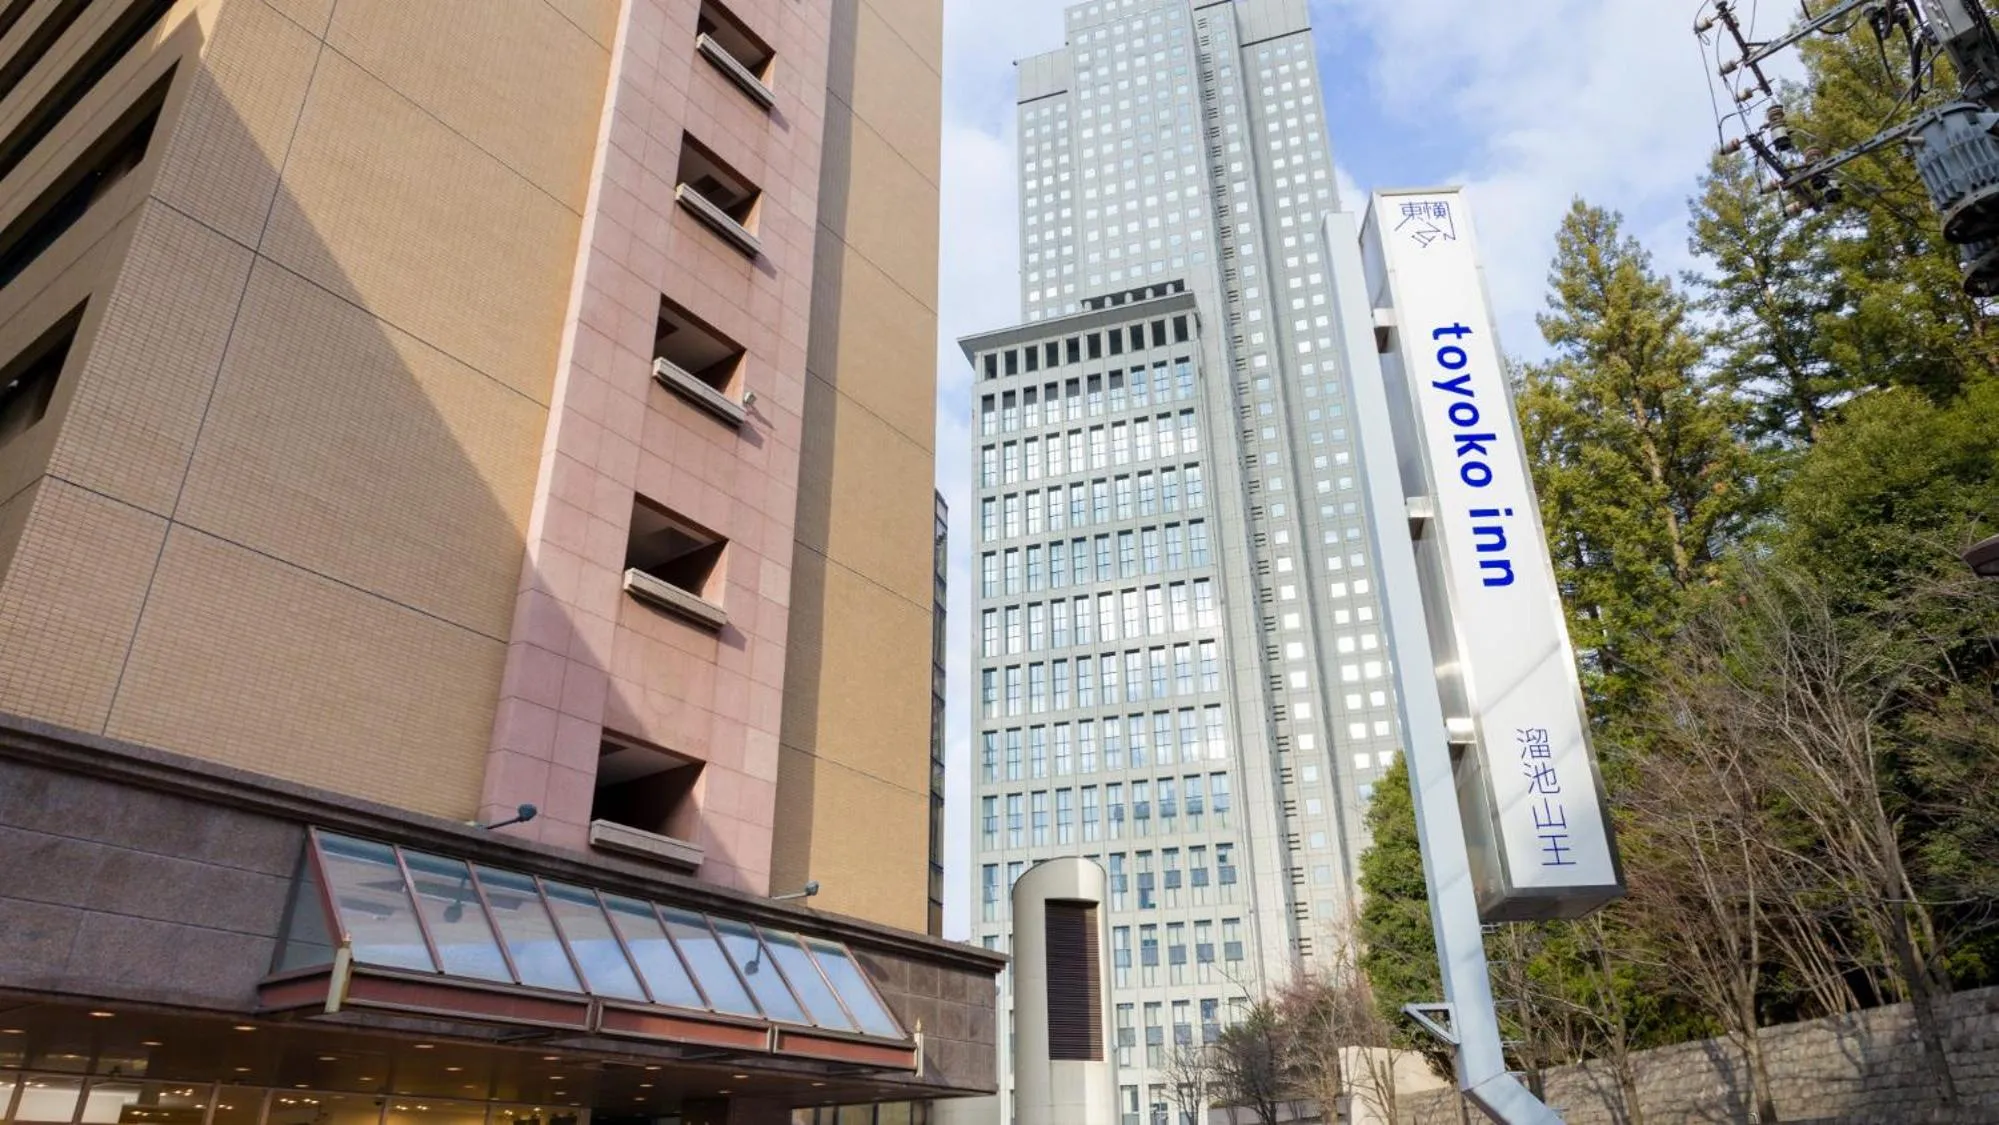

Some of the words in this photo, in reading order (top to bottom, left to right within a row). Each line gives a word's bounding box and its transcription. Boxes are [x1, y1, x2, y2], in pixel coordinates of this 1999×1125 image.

[1432, 322, 1497, 488] toyoko
[1469, 507, 1515, 588] inn
[1516, 727, 1577, 866] 溜池山王
